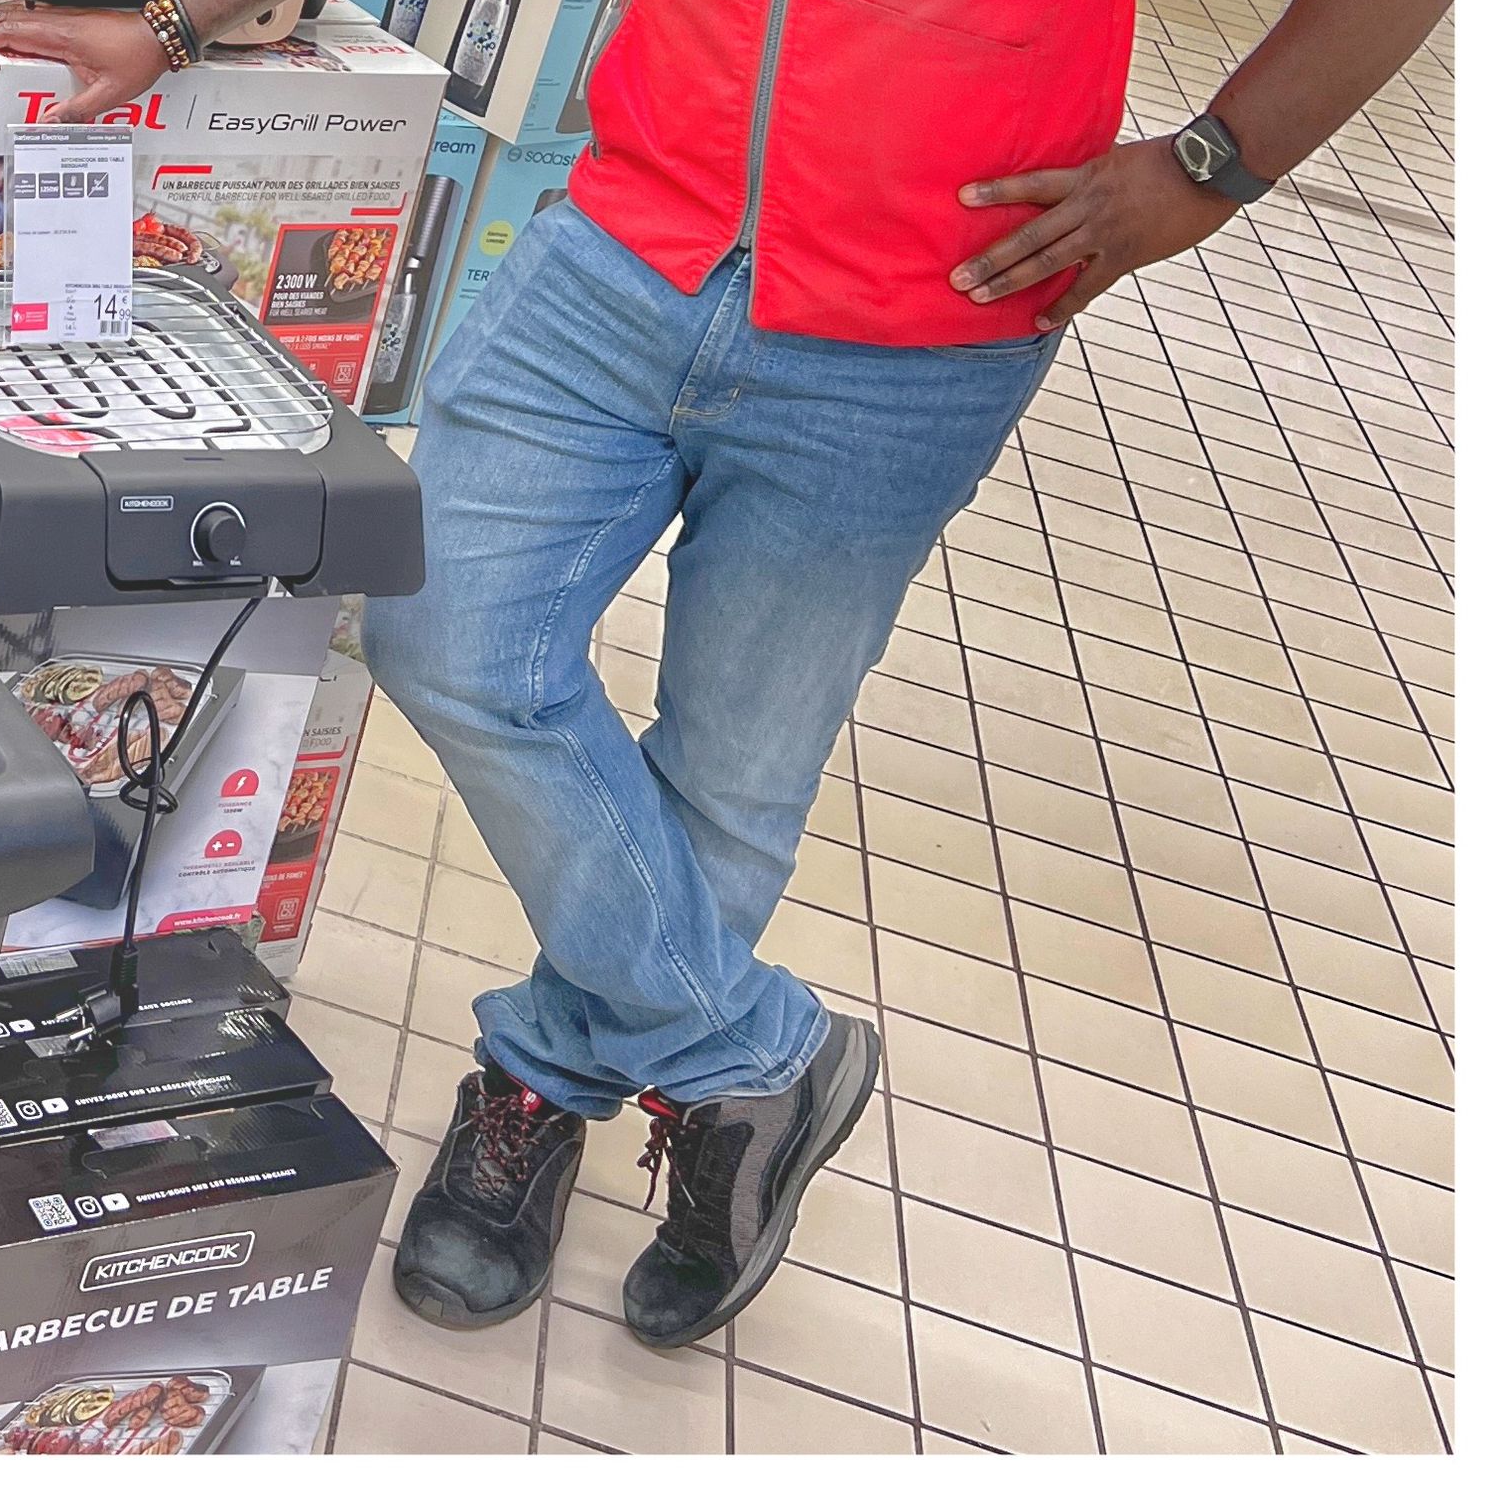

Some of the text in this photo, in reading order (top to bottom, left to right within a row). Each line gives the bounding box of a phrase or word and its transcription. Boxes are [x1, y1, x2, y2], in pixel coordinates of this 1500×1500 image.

[17, 91, 168, 131] Tal
[208, 112, 408, 135] EasyGrill Power
[162, 180, 401, 191] UN BARBECUE PUISSANT POUR DES GRILLADES BIEN SAISIES
[276, 273, 303, 289] 2300
[94, 293, 118, 320] 14
[93, 1241, 242, 1282] KITCHENCOOK
[166, 1290, 219, 1320] DE
[226, 1266, 333, 1310] TABLE
